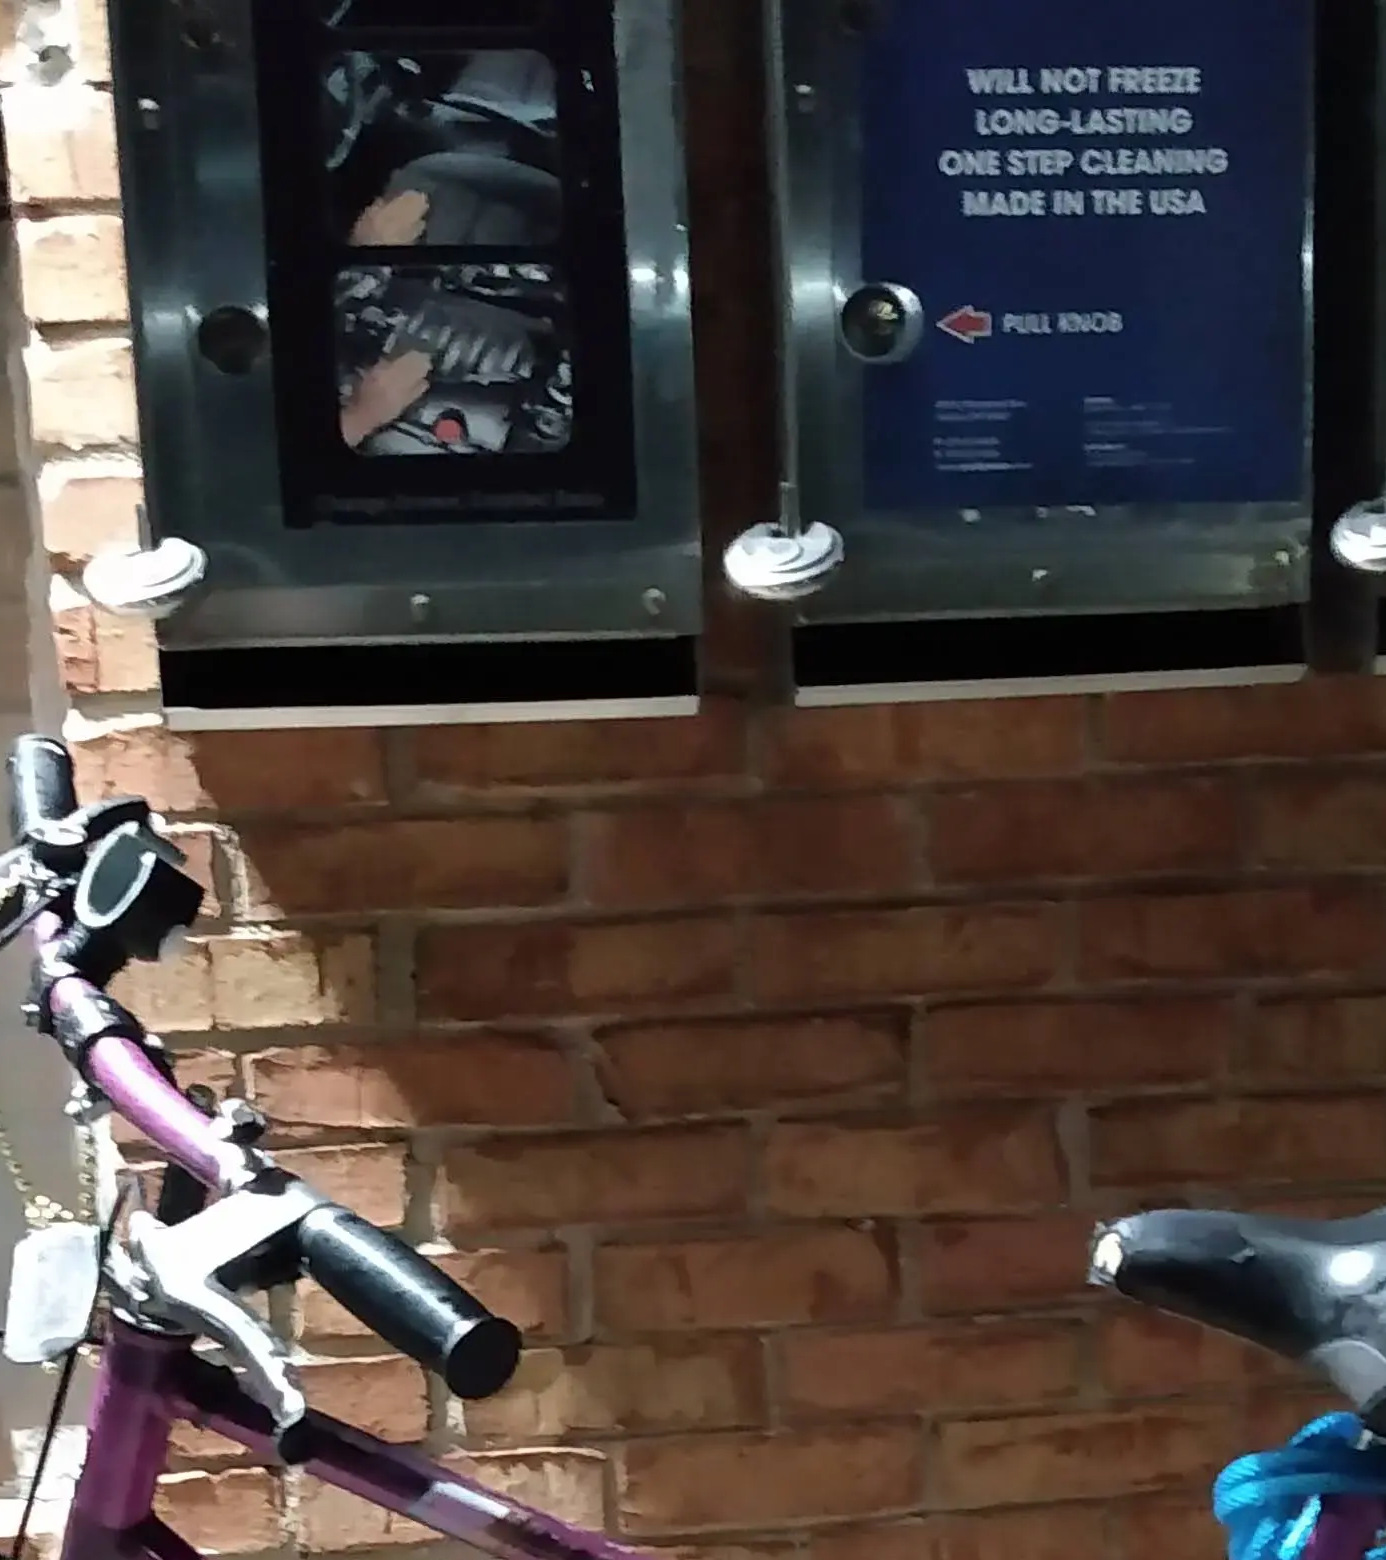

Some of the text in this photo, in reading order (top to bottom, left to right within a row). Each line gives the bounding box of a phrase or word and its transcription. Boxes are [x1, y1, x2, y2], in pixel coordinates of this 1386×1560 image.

[966, 66, 1201, 95] WILL NOT FREEZE
[974, 107, 1193, 135] LONG-LASTING
[938, 148, 1228, 176] ONE STEP CLEANING
[962, 188, 1207, 216] MADE IN THE USA
[1002, 311, 1124, 334] PULL KNOB
